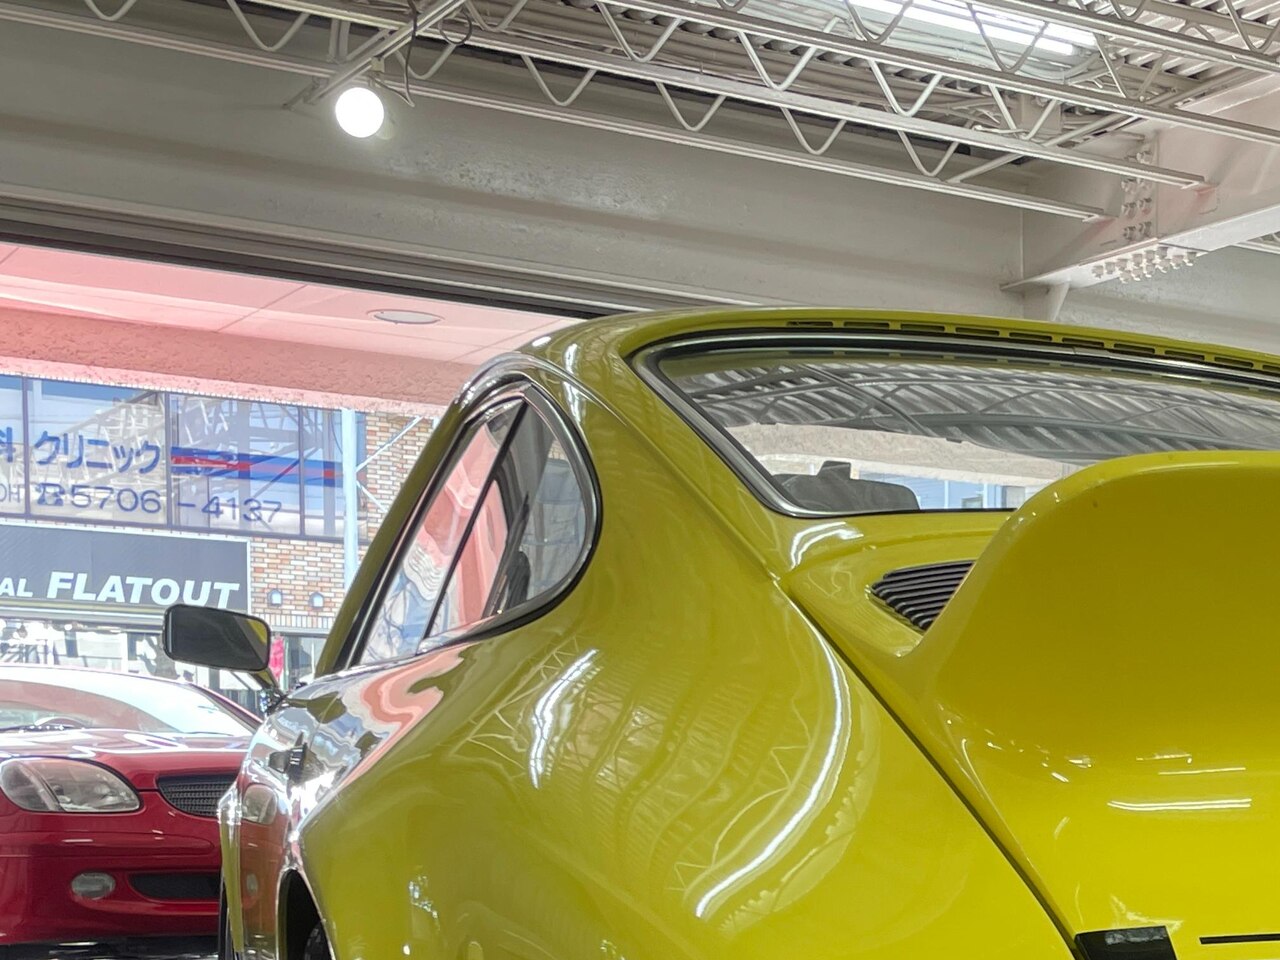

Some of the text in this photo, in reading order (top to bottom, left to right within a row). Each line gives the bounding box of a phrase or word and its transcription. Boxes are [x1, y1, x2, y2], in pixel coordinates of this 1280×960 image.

[34, 430, 162, 474] クリニック
[46, 571, 240, 609] FLATOUT
